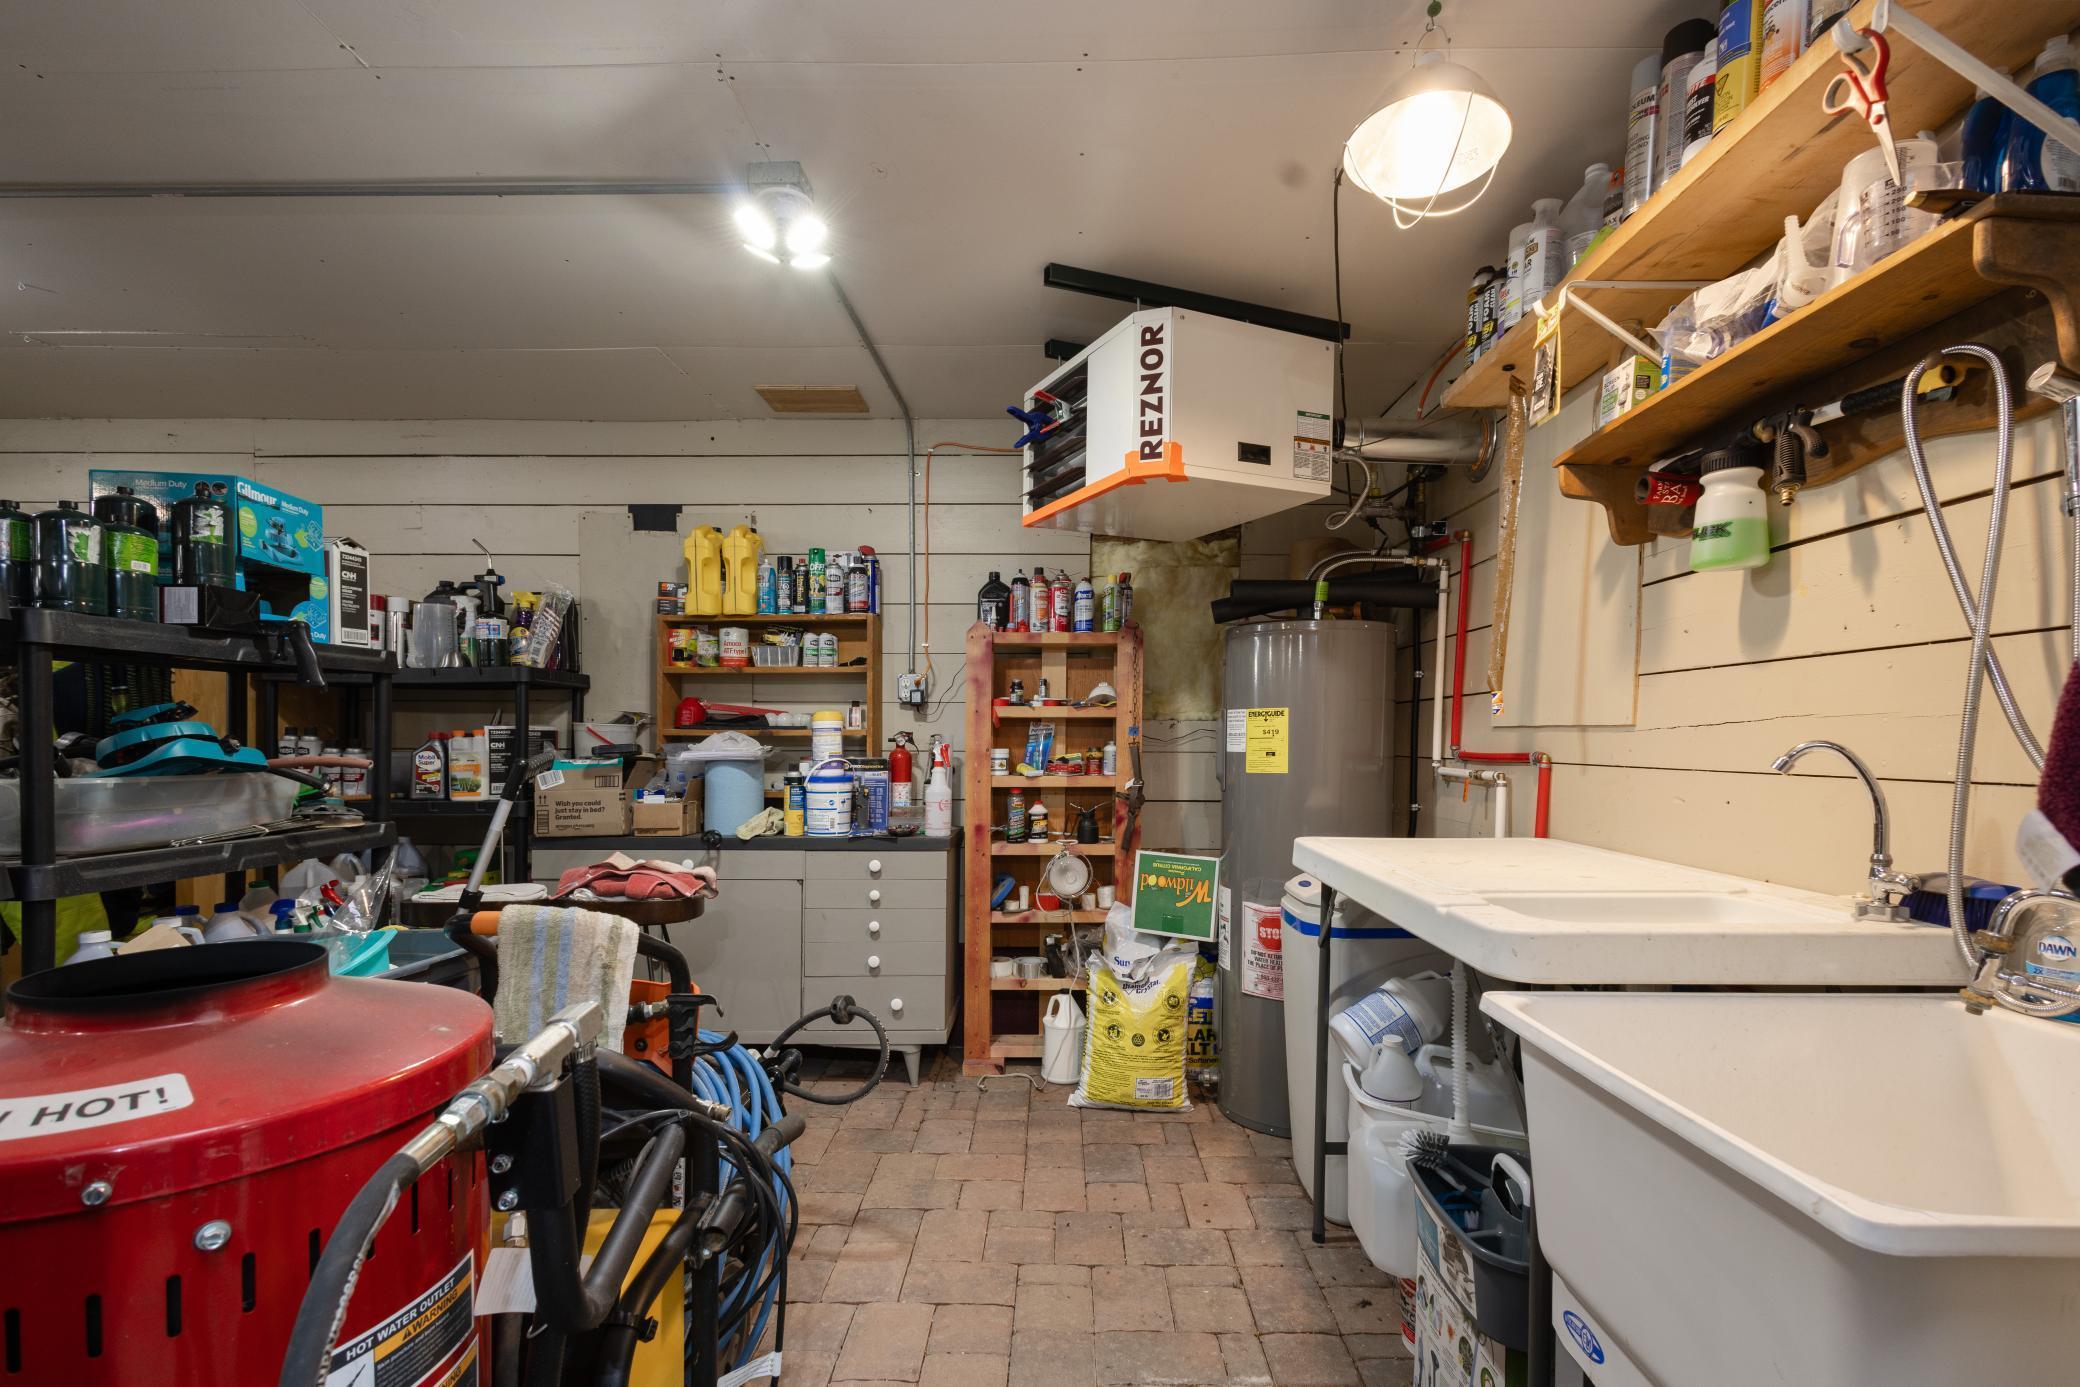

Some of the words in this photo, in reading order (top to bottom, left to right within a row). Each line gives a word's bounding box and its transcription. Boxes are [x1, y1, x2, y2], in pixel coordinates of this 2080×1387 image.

[1140, 323, 1164, 462] REZNOR
[135, 478, 167, 488] Medium
[168, 480, 187, 490] Duty
[236, 481, 278, 506] Gilmour
[281, 500, 299, 514] Medium
[298, 506, 309, 517] Duty
[809, 562, 825, 571] OFF!
[566, 807, 581, 815] stay
[1171, 864, 1202, 872] CALIFORNIA
[1140, 873, 1212, 907] Wildwood
[1259, 926, 1282, 940] STO
[2038, 941, 2077, 958] DAWN
[1113, 956, 1131, 967] Sun
[2033, 967, 2044, 975] 2X
[30, 1086, 169, 1126] HOT!
[345, 1337, 376, 1361] HOT
[376, 1308, 418, 1342] WATER
[419, 1277, 456, 1311] OUTLET
[411, 1288, 459, 1333] WARNING
